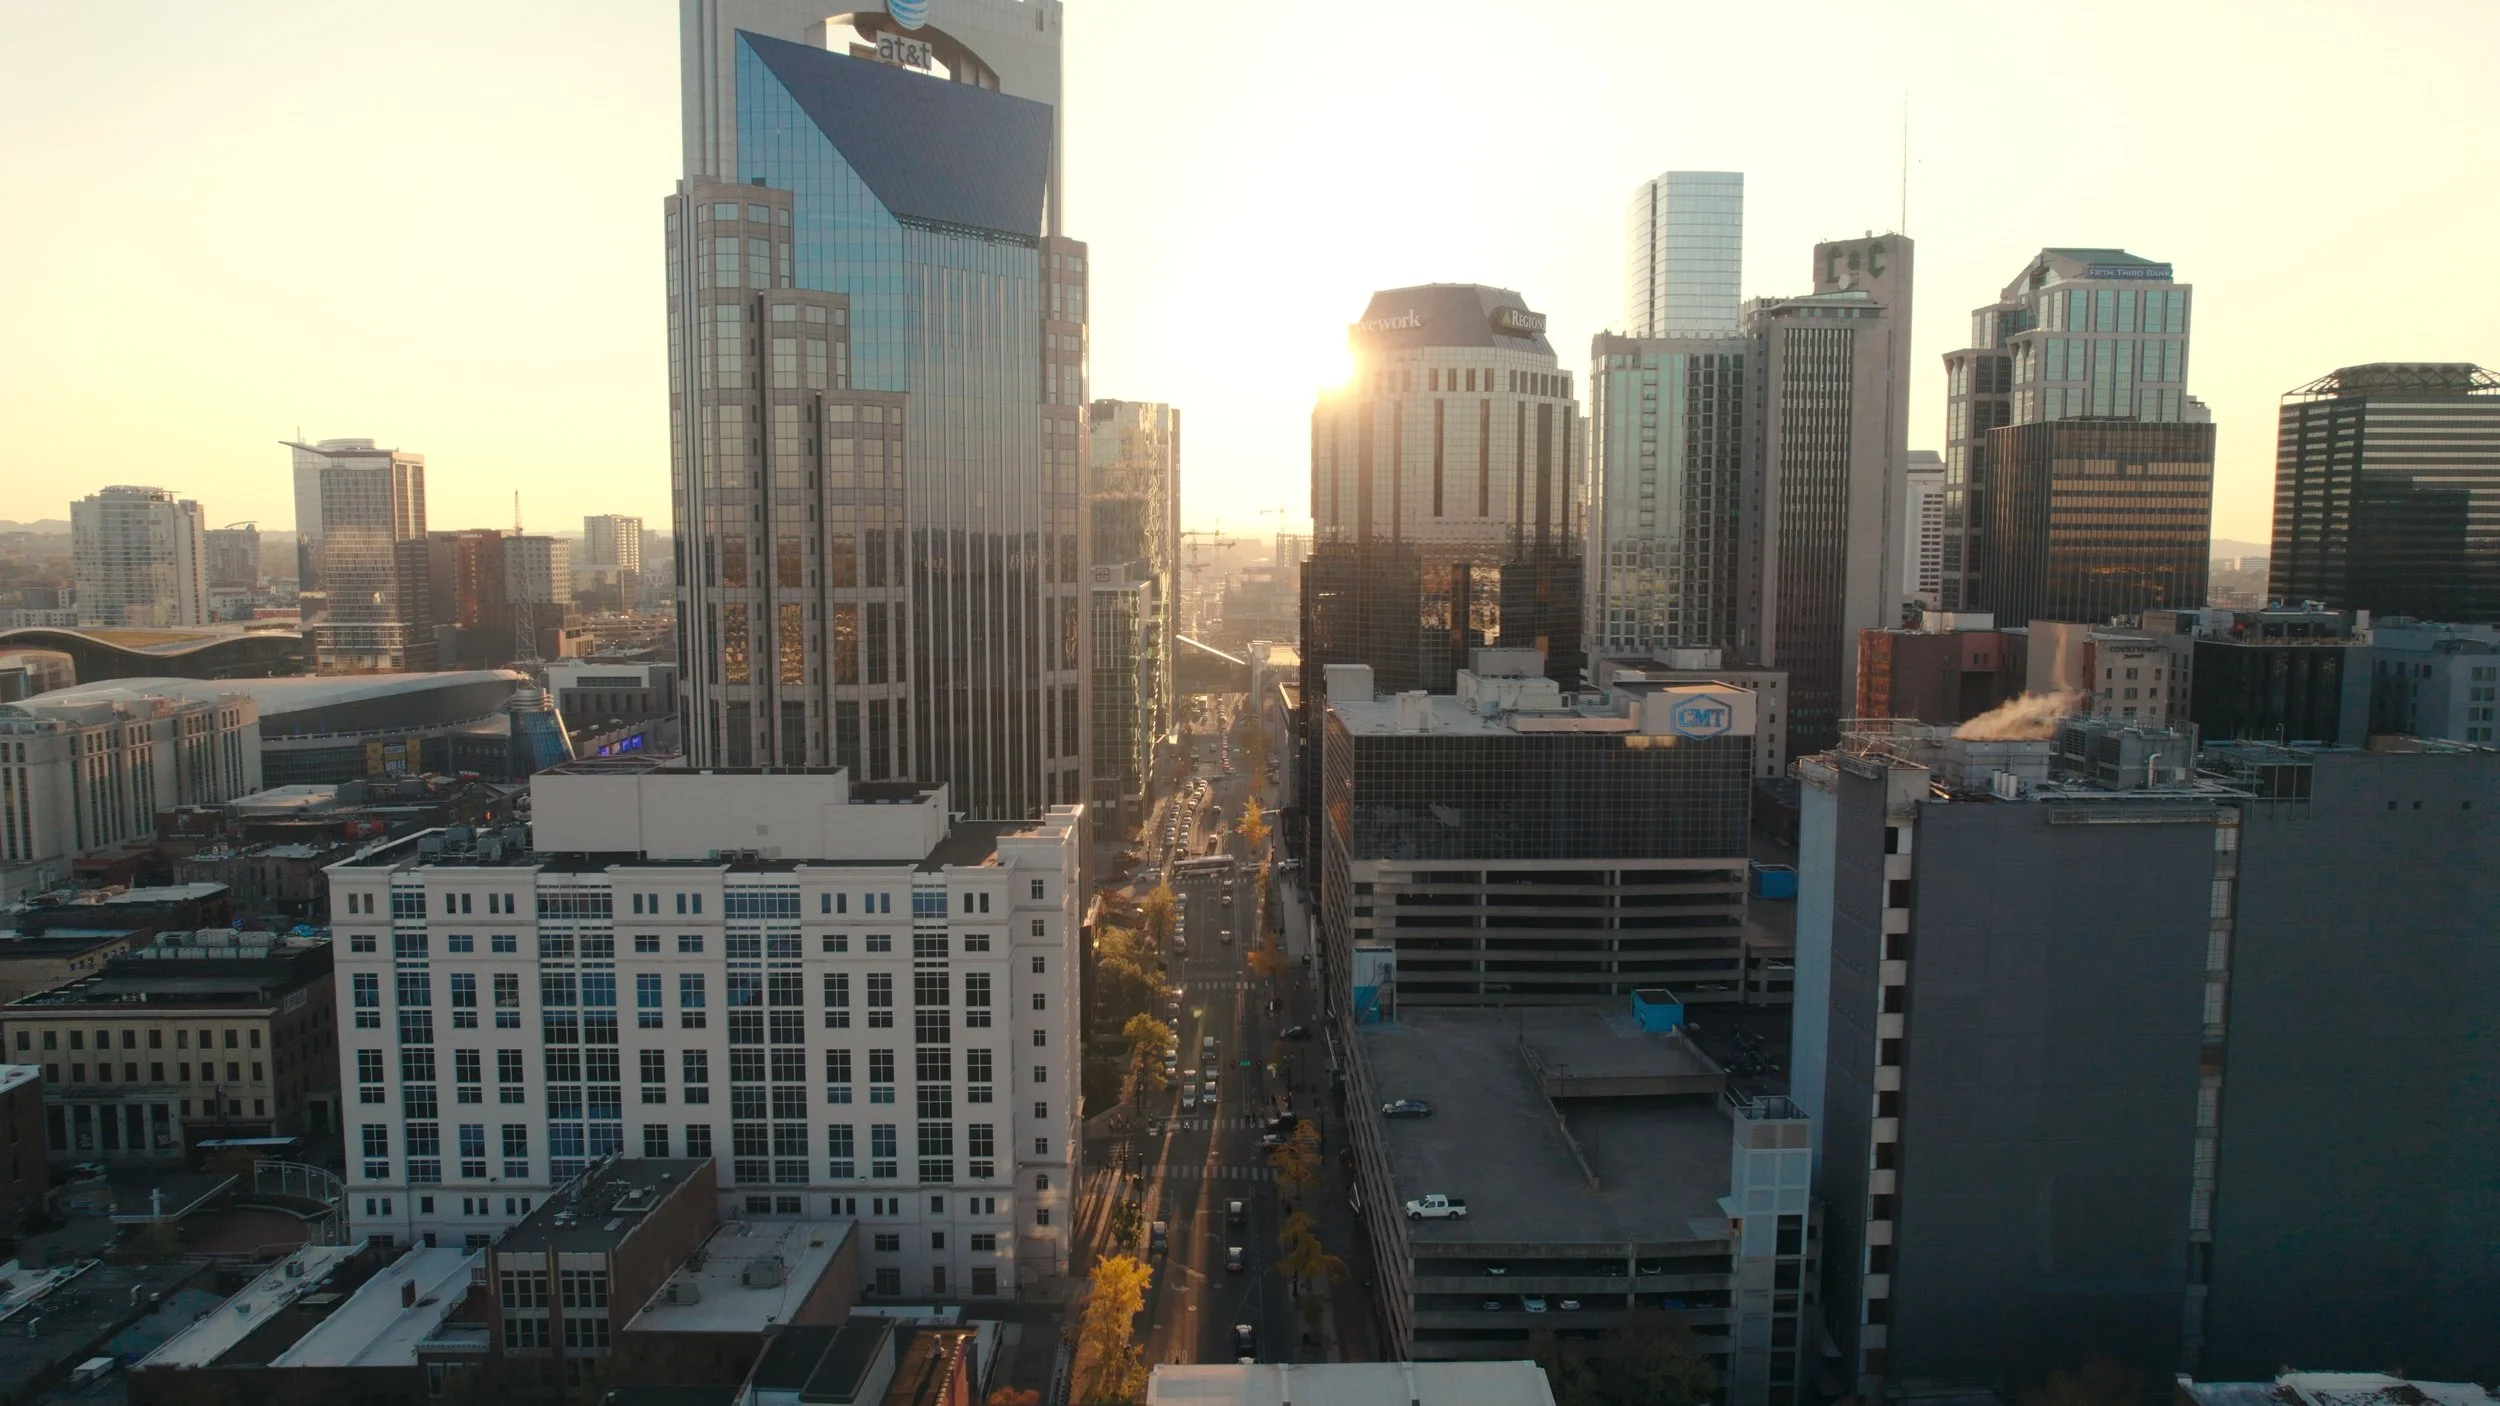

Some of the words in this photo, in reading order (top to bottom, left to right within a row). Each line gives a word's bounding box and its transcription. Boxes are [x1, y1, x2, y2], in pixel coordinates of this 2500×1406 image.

[879, 36, 931, 70] at&t
[2089, 268, 2114, 276] FIFTH
[2117, 268, 2144, 277] THIRD
[2146, 268, 2171, 277] BANK
[1511, 310, 1547, 329] REGIONS
[1679, 708, 1726, 728] CMT
